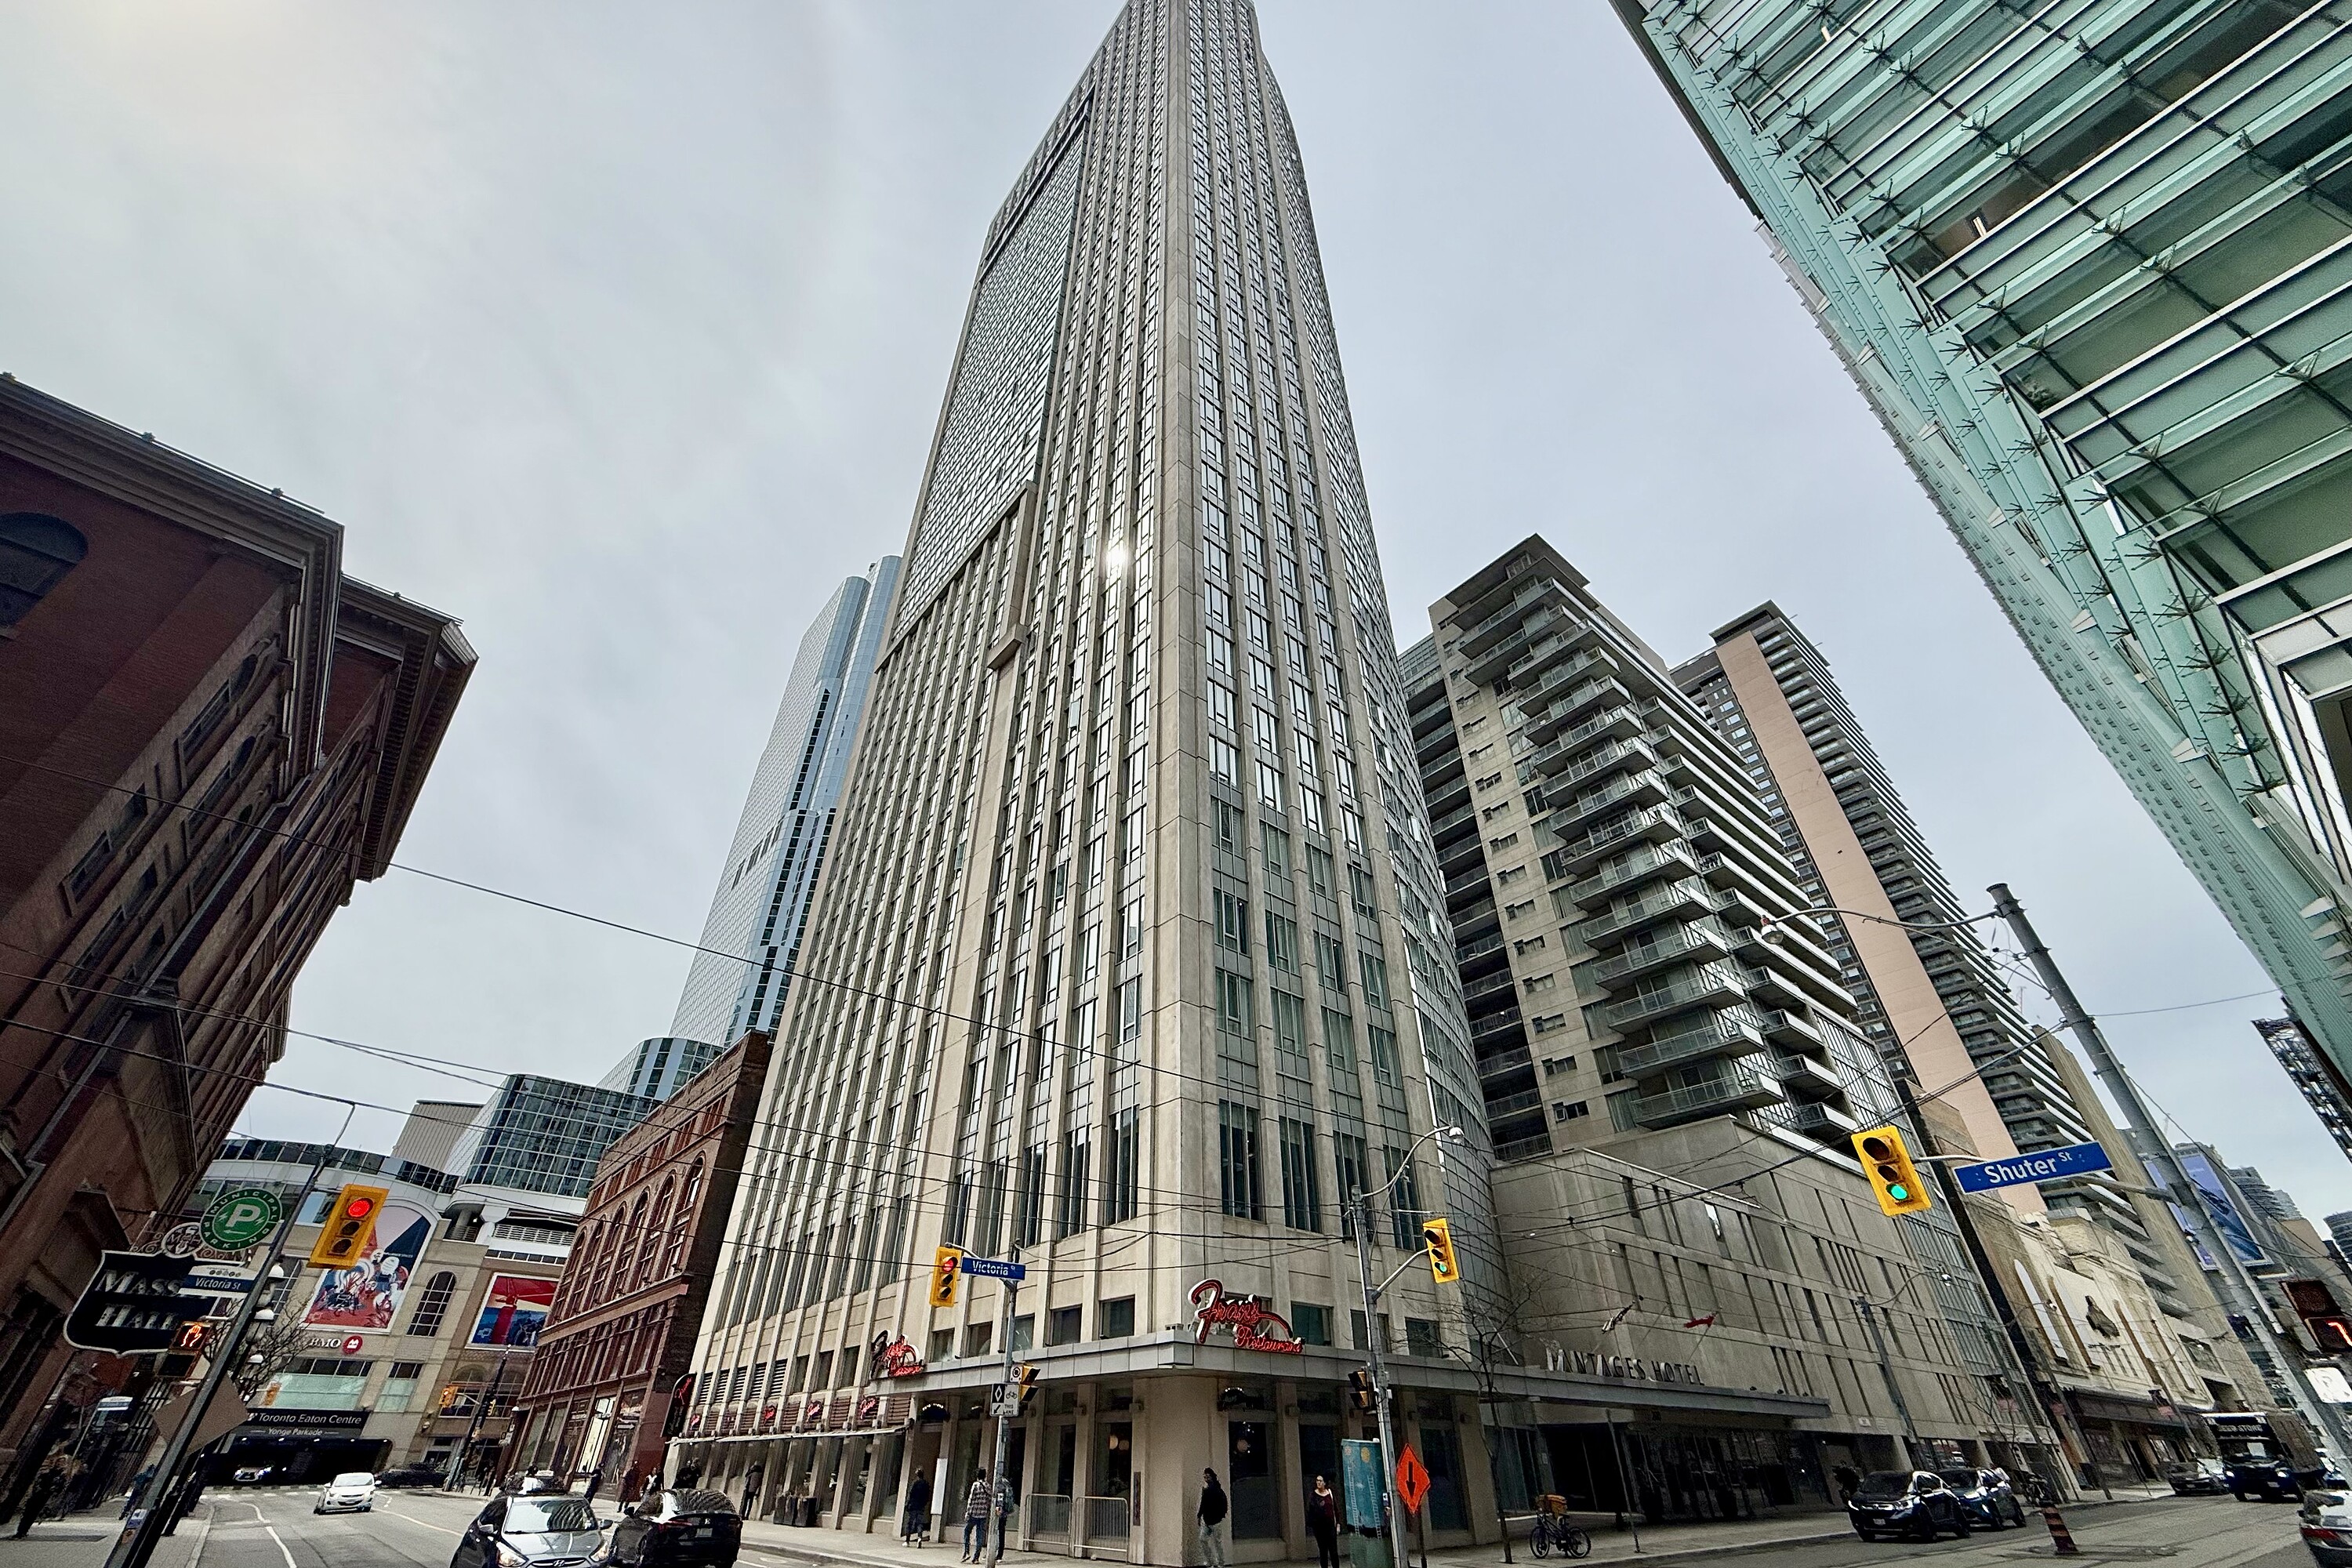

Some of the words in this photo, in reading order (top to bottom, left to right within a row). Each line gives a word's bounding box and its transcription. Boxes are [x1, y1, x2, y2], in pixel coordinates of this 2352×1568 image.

[1984, 1157, 2058, 1184] Shuter
[2057, 1151, 2073, 1162] St
[210, 1191, 277, 1220] MUNICIPAL
[225, 1203, 261, 1228] P
[204, 1221, 270, 1248] PARKING
[973, 1261, 1009, 1276] Victoria
[94, 1269, 209, 1299] MASS
[195, 1277, 232, 1289] Victoria
[1651, 1360, 1705, 1386] HOTEL
[258, 1413, 296, 1423] Toronto
[297, 1414, 327, 1424] Eaton
[328, 1414, 362, 1425] Centre
[292, 1428, 323, 1436] Parkade
